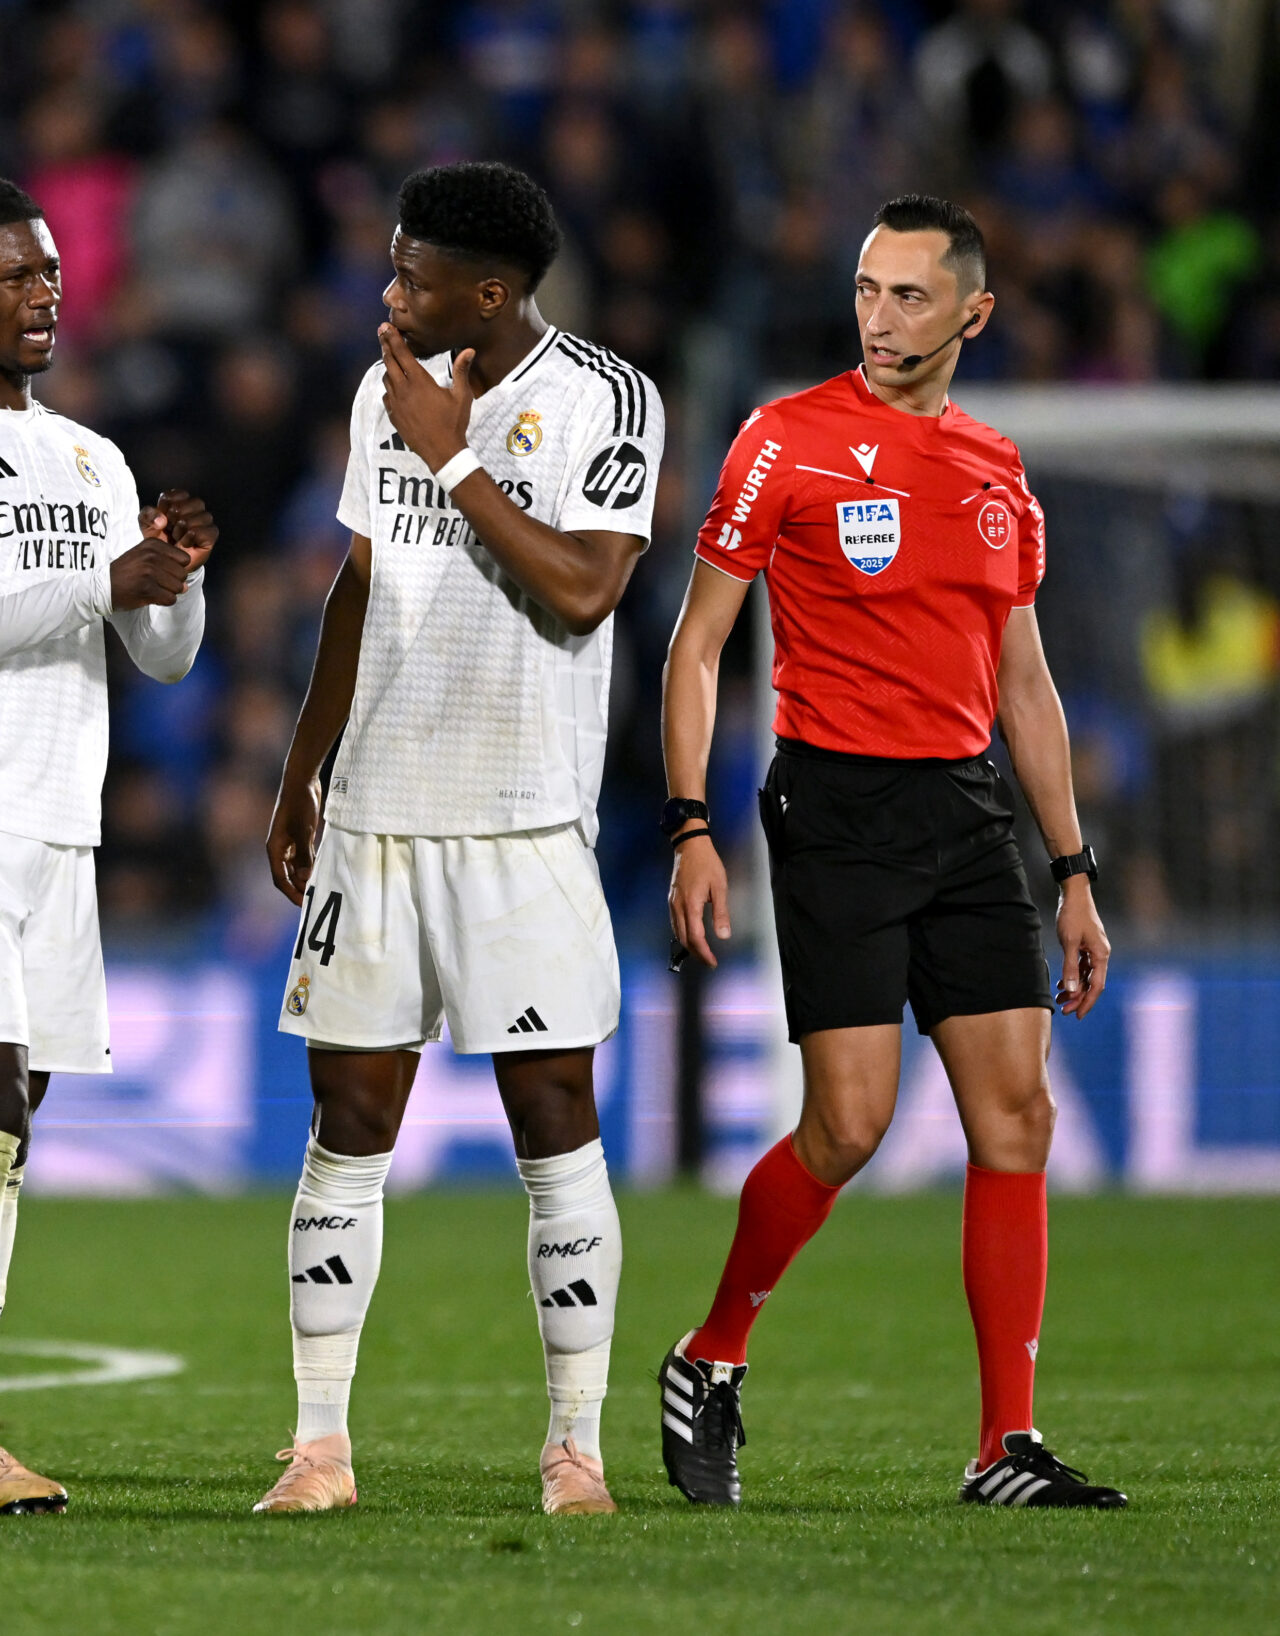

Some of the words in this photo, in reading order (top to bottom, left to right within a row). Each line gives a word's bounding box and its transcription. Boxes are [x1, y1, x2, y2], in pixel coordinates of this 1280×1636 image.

[378, 467, 533, 511] Emies
[731, 440, 782, 523] WÜRTH
[843, 504, 894, 523] FIFA
[390, 513, 428, 545] FLY
[845, 533, 895, 544] REFEREE
[860, 558, 884, 569] 2025
[294, 885, 343, 967] 14
[293, 1215, 359, 1233] RMCF
[536, 1236, 603, 1260] RMCF
